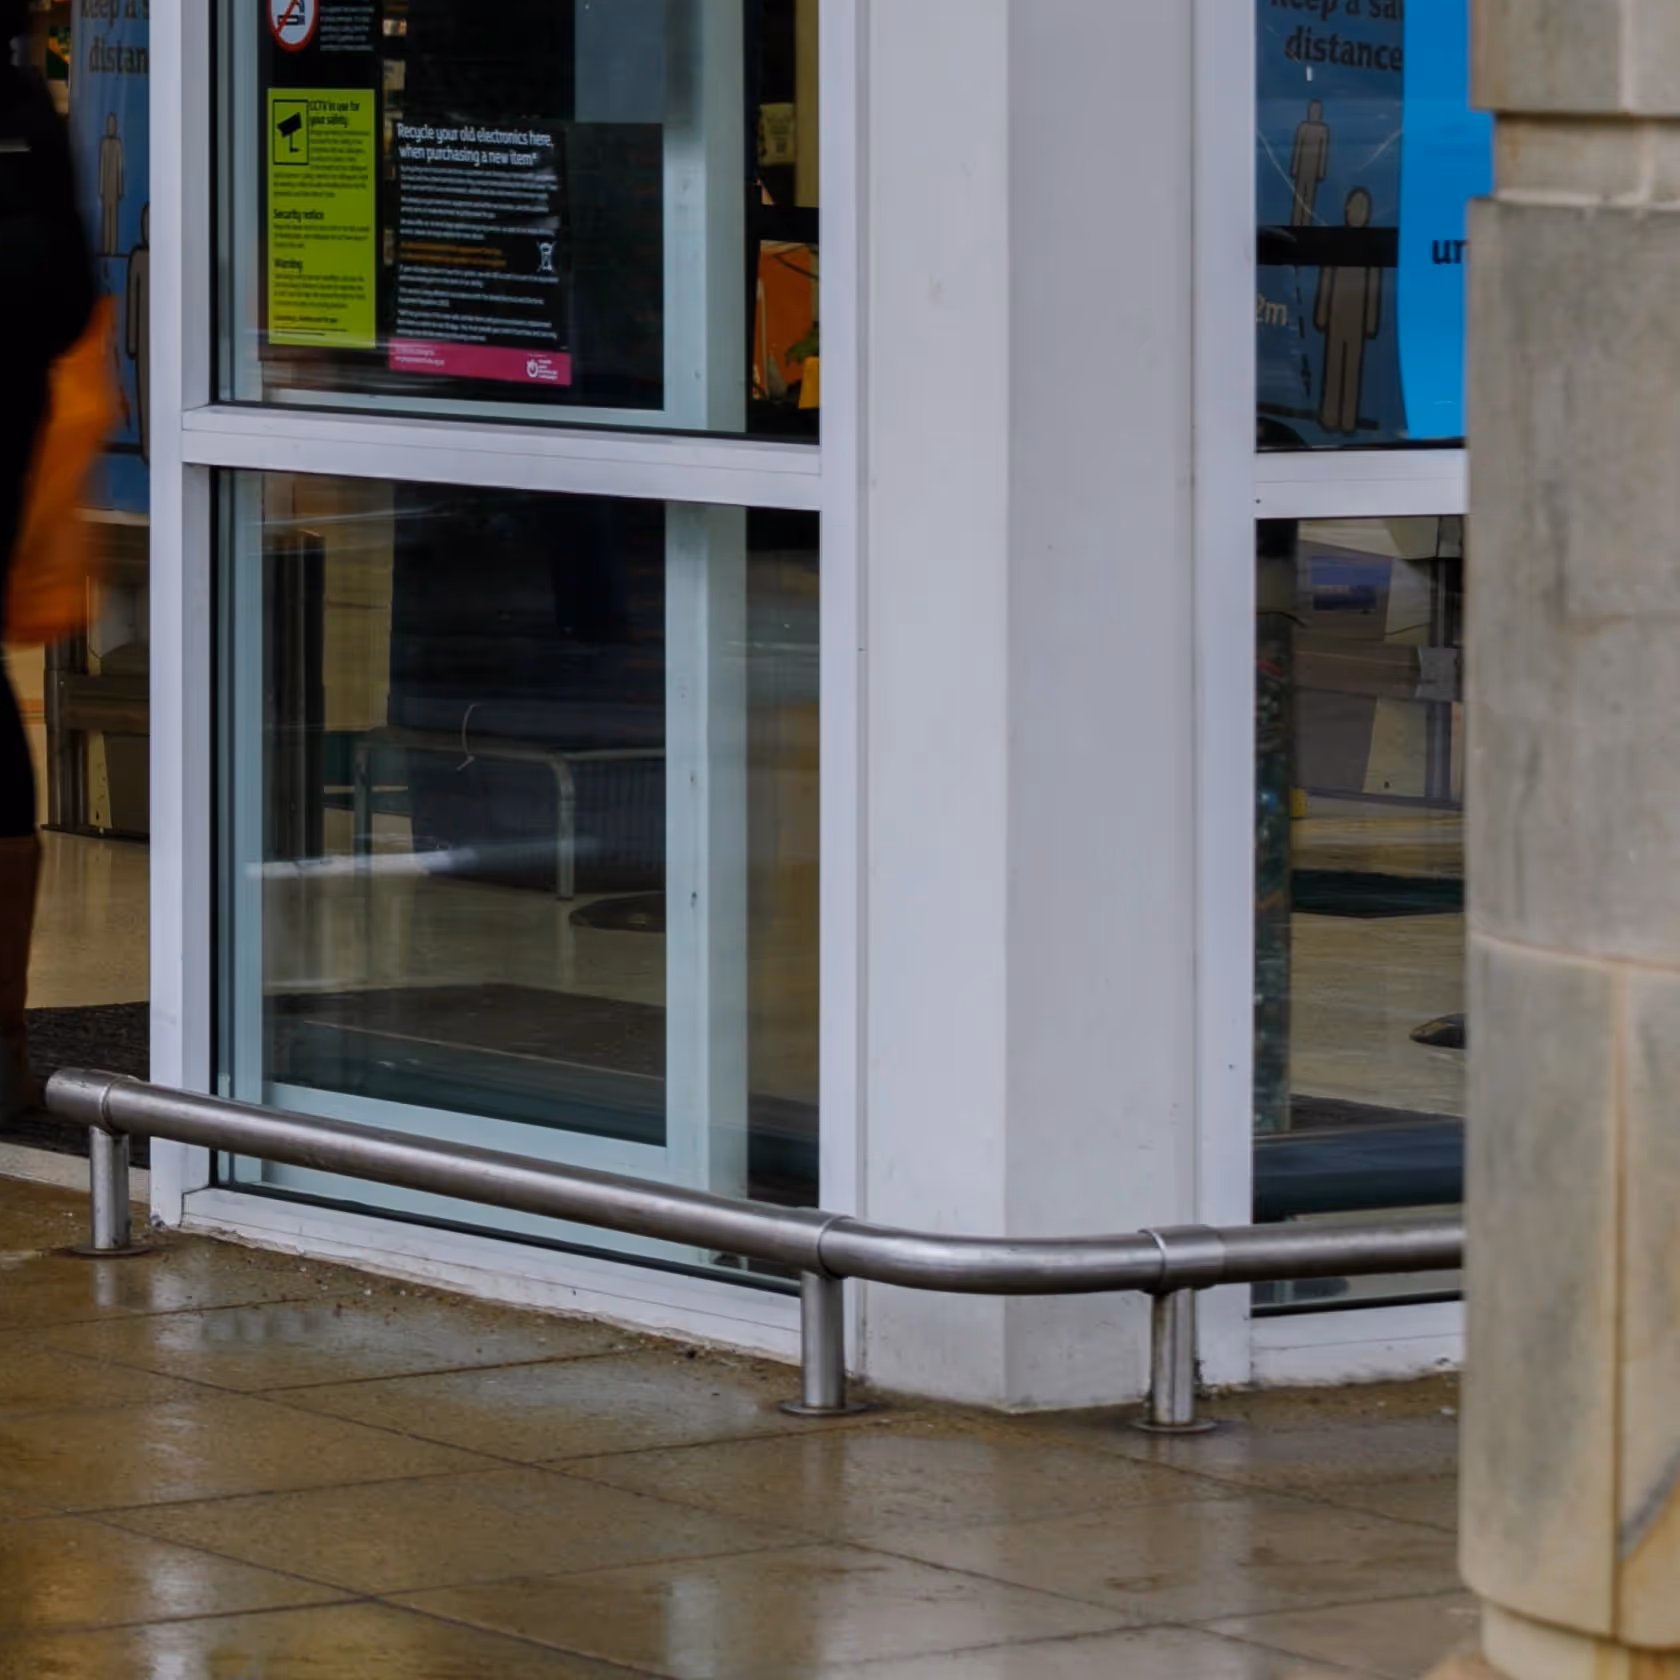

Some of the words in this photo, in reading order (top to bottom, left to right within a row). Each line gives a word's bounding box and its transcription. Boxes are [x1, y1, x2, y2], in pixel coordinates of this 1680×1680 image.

[397, 123, 435, 144] Recycle
[436, 127, 458, 144] your
[460, 125, 476, 142] old
[477, 126, 528, 145] electronics
[399, 142, 426, 158] when
[426, 145, 480, 167] purchasing
[481, 151, 488, 162] a
[489, 151, 509, 164] new
